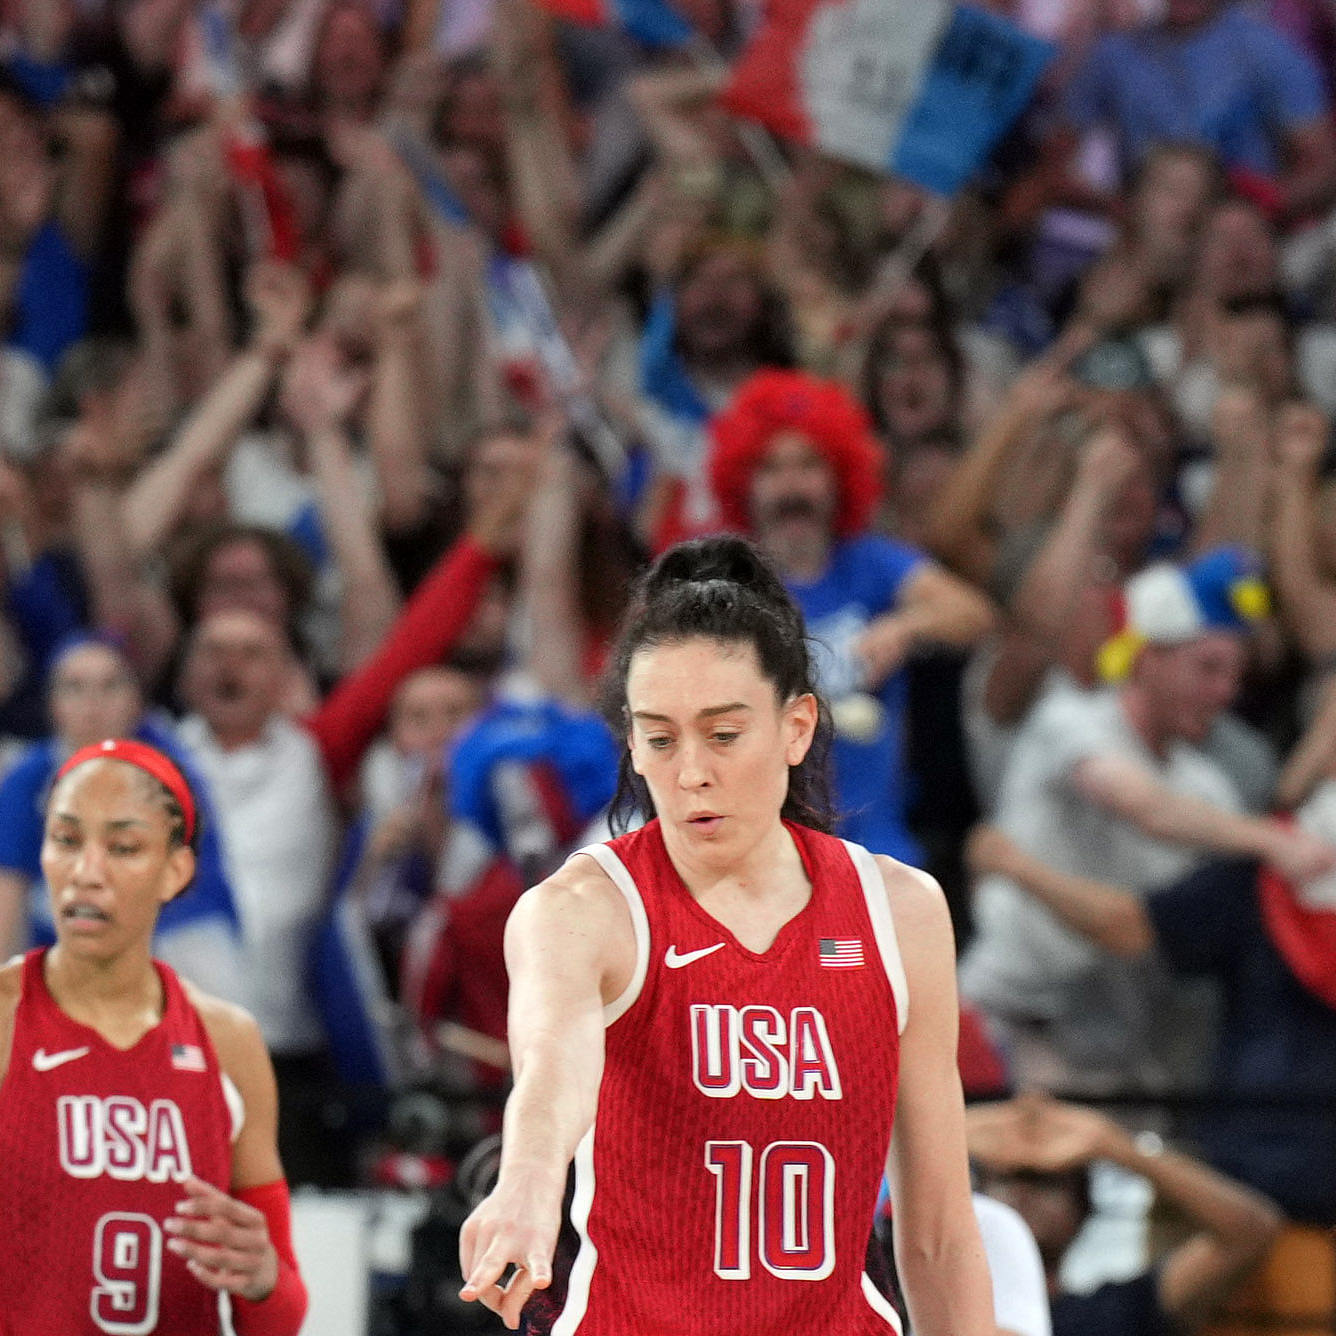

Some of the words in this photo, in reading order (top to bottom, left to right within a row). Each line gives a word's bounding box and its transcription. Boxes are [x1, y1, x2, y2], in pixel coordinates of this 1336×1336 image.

[690, 1004, 843, 1100] USA
[57, 1095, 192, 1184] USA
[704, 1140, 836, 1281] 10
